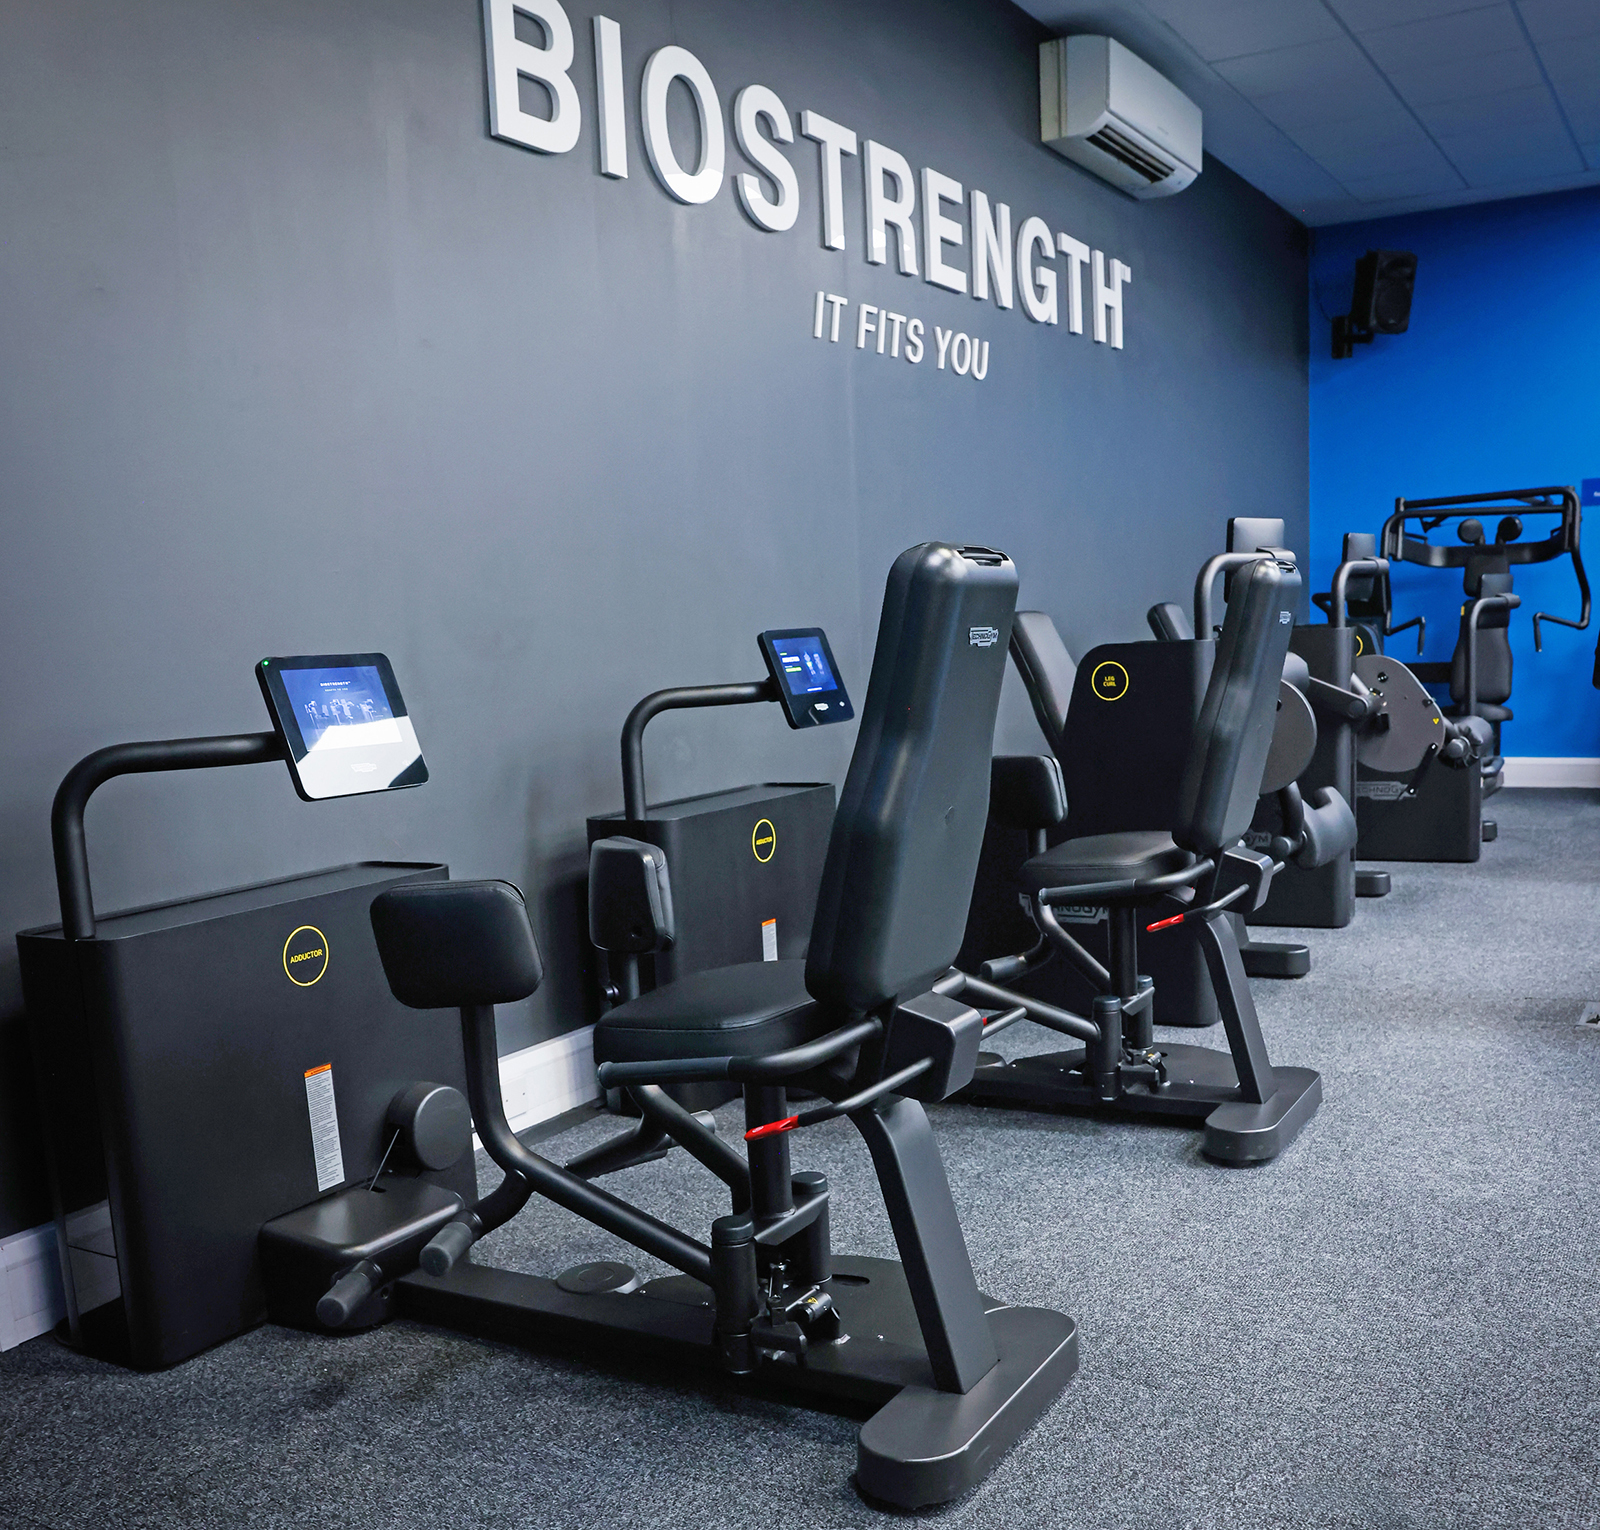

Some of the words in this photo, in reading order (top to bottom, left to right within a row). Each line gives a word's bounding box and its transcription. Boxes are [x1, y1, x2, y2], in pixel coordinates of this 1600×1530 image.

[483, 0, 1131, 349] BIOSTRENGTH
[813, 291, 848, 343] IT
[856, 303, 926, 364] FITS
[933, 326, 990, 380] YOU
[290, 948, 323, 964] ADDUCTOR
